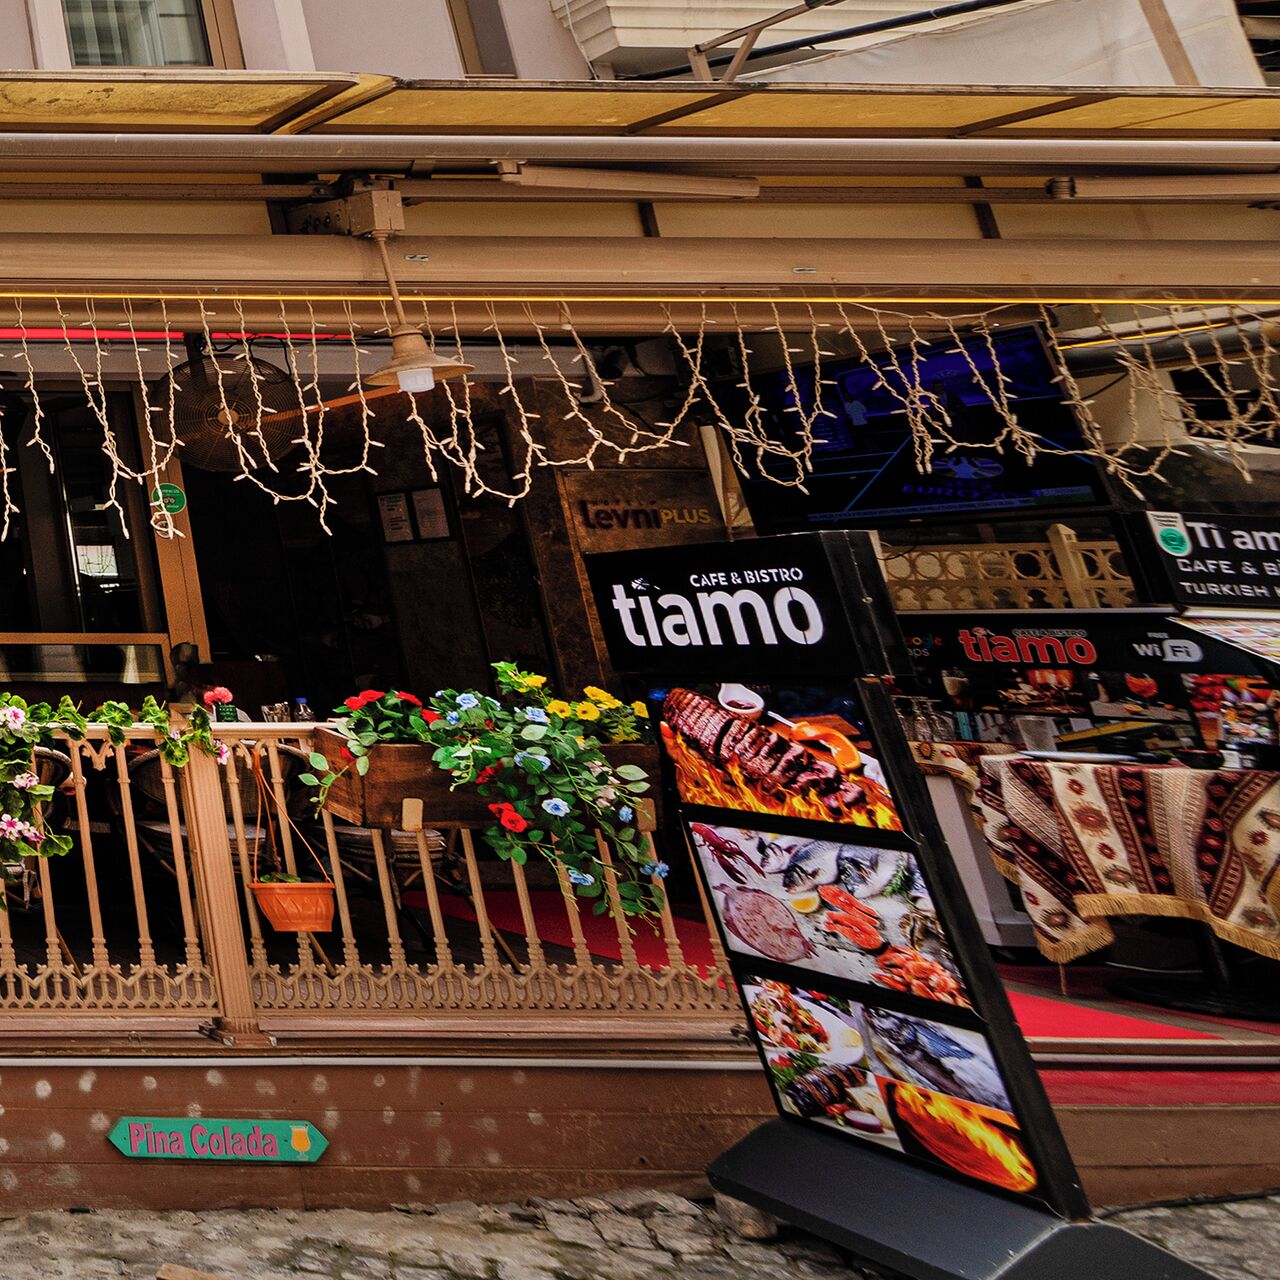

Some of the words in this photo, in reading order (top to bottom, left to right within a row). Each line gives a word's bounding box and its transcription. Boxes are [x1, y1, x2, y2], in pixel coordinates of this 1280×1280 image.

[660, 508, 712, 525] PLUS
[1186, 521, 1226, 549] Ti
[690, 572, 727, 588] CAFE
[731, 570, 742, 584] &
[743, 566, 804, 584] BISTRO
[1176, 559, 1236, 575] CAFE
[1241, 561, 1259, 576] &
[1179, 581, 1271, 598] TURKISH
[612, 583, 825, 647] tiamo
[959, 628, 1098, 665] tiamo
[127, 1122, 186, 1156] Pina
[190, 1123, 279, 1158] Colada
